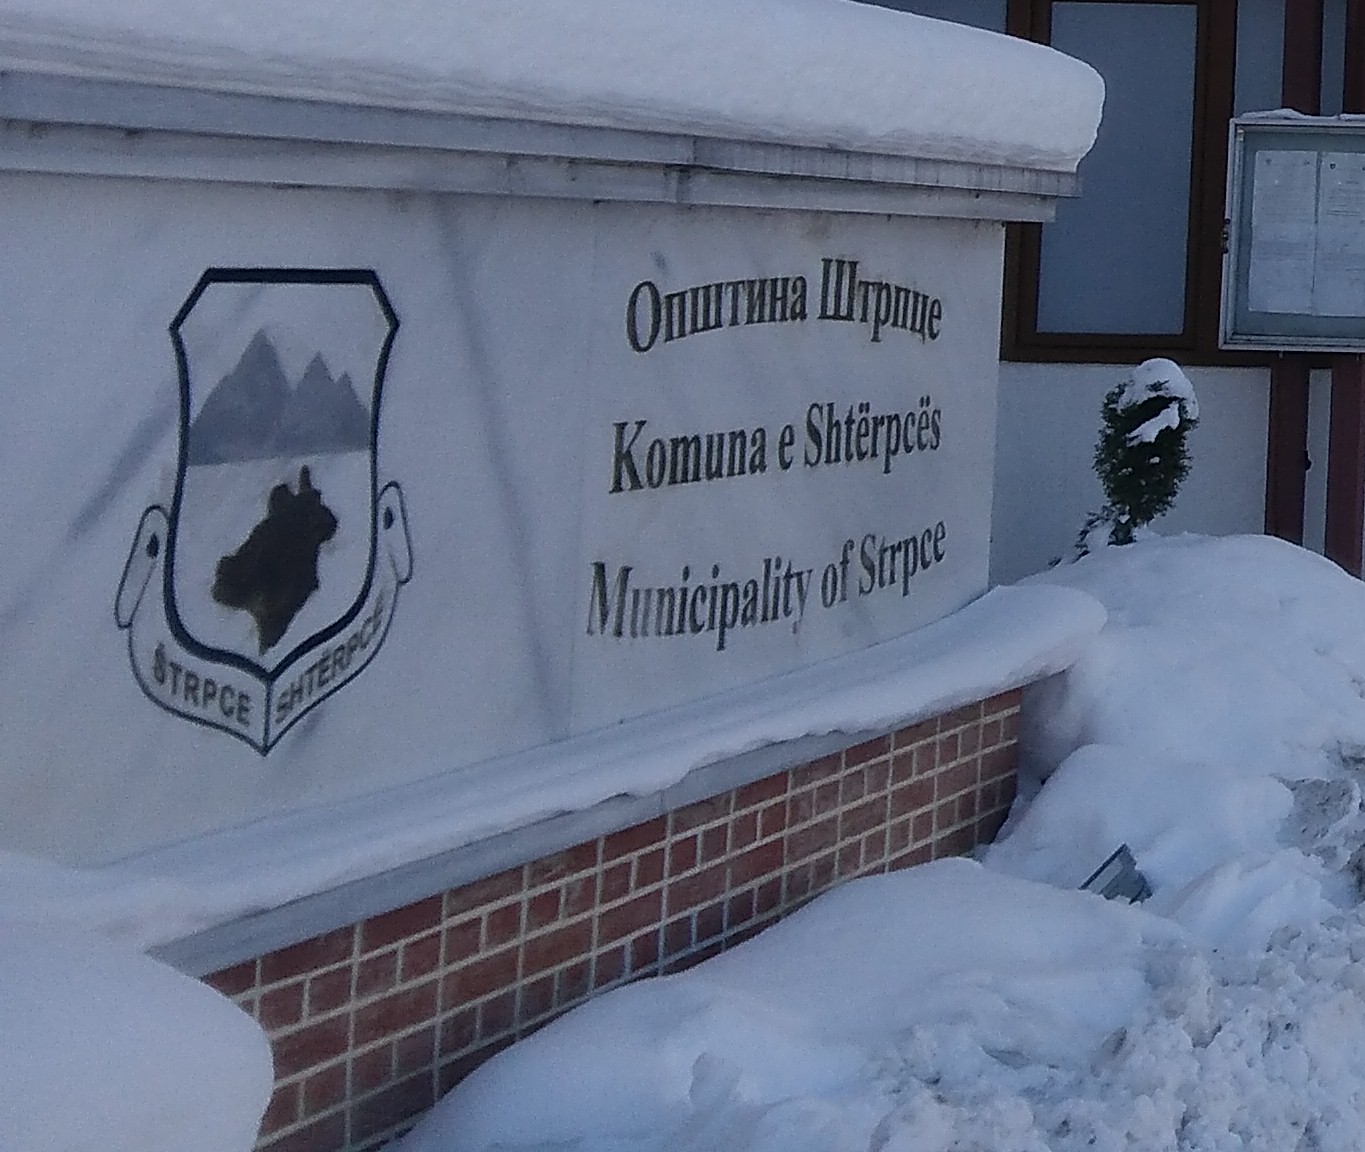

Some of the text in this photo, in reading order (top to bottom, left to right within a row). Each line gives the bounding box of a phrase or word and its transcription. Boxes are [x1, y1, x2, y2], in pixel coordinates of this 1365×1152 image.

[626, 257, 943, 352] Општина Штрпце
[609, 395, 942, 494] Komuna e Shtërpcës
[586, 520, 947, 652] Municipality of Strpce
